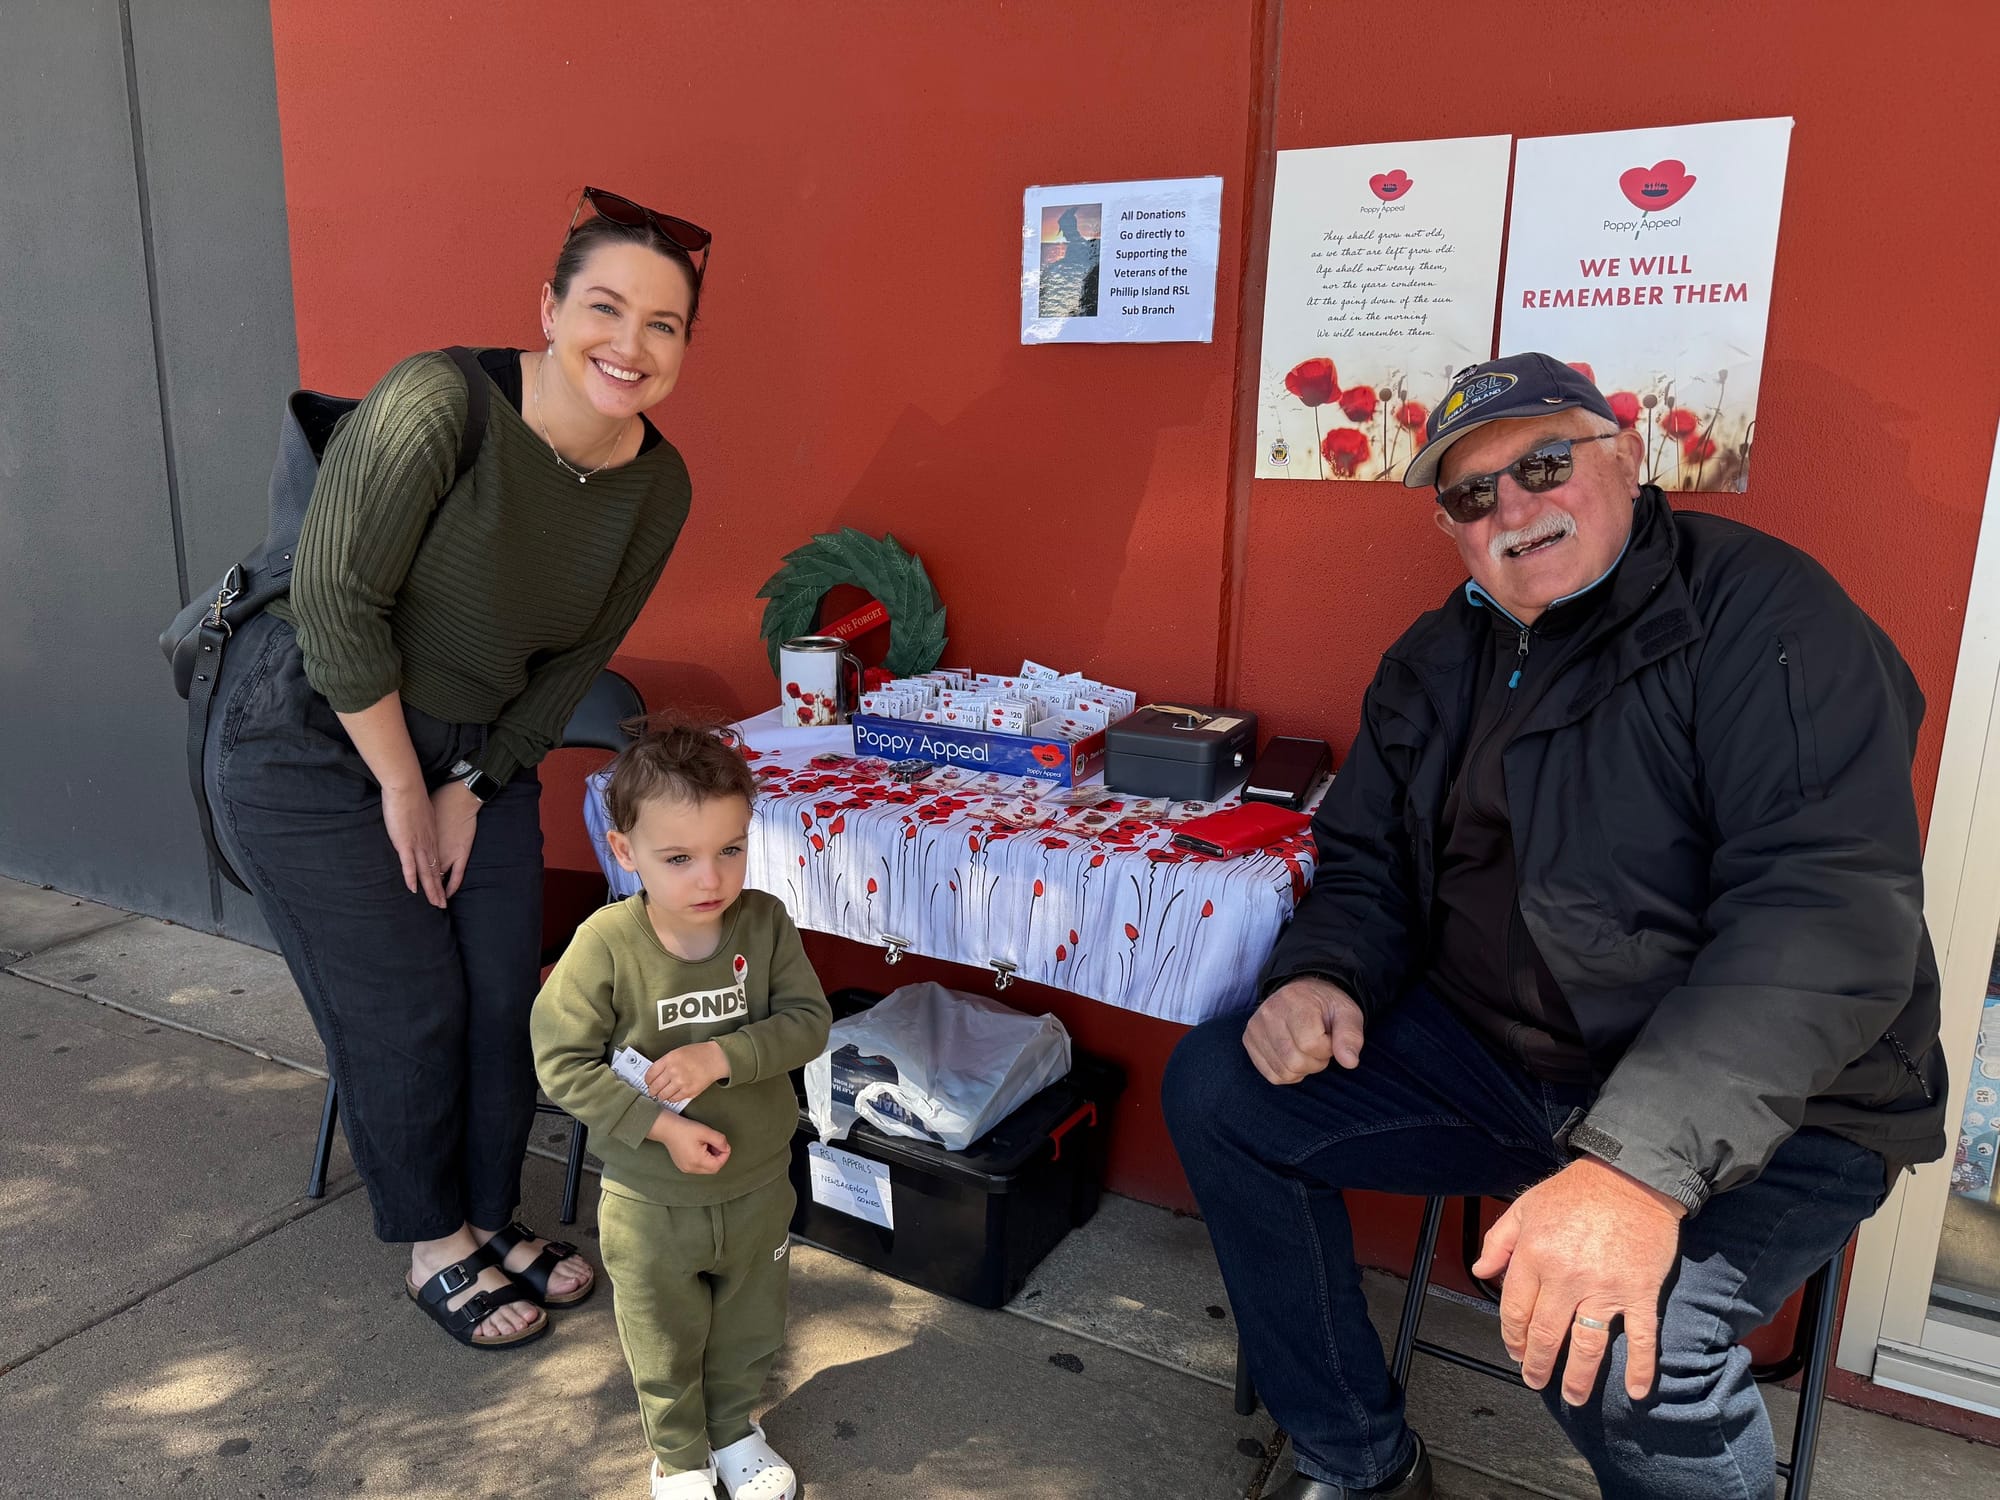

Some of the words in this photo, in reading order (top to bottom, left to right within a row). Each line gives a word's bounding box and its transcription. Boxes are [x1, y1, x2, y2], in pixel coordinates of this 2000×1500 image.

[1121, 210, 1134, 221] All
[1136, 209, 1186, 220] Donations
[1360, 206, 1380, 214] Poppy
[1381, 204, 1405, 213] Appeal
[1603, 220, 1638, 232] Poppy
[1640, 216, 1681, 231] Appeal
[1120, 230, 1133, 240] Go
[1136, 228, 1172, 240] directly
[1174, 229, 1185, 238] to
[1323, 230, 1343, 245] They
[1347, 230, 1375, 239] shall
[1378, 232, 1401, 244] grow
[1425, 227, 1445, 240] old,
[1116, 248, 1168, 260] Supporting
[1171, 247, 1187, 257] the
[1341, 248, 1366, 256] that
[1385, 246, 1407, 260] left
[1408, 248, 1432, 260] grow
[1114, 268, 1156, 278] Veterans
[1159, 266, 1169, 276] of
[1171, 266, 1188, 276] the
[1316, 264, 1333, 278] Age
[1336, 263, 1363, 272] shall
[1386, 265, 1415, 275] weary
[1579, 258, 1621, 278] WE
[1629, 255, 1693, 276] WILL
[1110, 286, 1139, 298] Phillip
[1142, 286, 1170, 296] Island
[1173, 285, 1190, 295] RSL
[1342, 280, 1358, 288] the
[1361, 282, 1388, 293] years
[1306, 297, 1321, 305] At
[1322, 297, 1337, 305] the
[1341, 296, 1367, 310] going
[1400, 296, 1410, 309] of
[1413, 295, 1429, 303] the
[1522, 286, 1664, 309] REMEMBER
[1673, 283, 1748, 305] THEM
[1122, 305, 1139, 315] Sub
[1142, 304, 1175, 315] Branch
[1328, 313, 1346, 321] and
[1350, 312, 1362, 320] in
[1366, 312, 1380, 320] the
[1384, 310, 1428, 325] morning
[1317, 329, 1329, 338] We
[1333, 328, 1355, 337] will
[1357, 328, 1404, 336] remember
[1464, 376, 1502, 400] RSL
[857, 725, 914, 755] Poppy
[920, 735, 989, 762] Appeal
[1026, 767, 1042, 776] Poppy
[1043, 769, 1062, 778] Appeal
[662, 988, 746, 1025] BONDS
[820, 1148, 836, 1162] RSL
[842, 1156, 872, 1174] APPEALS
